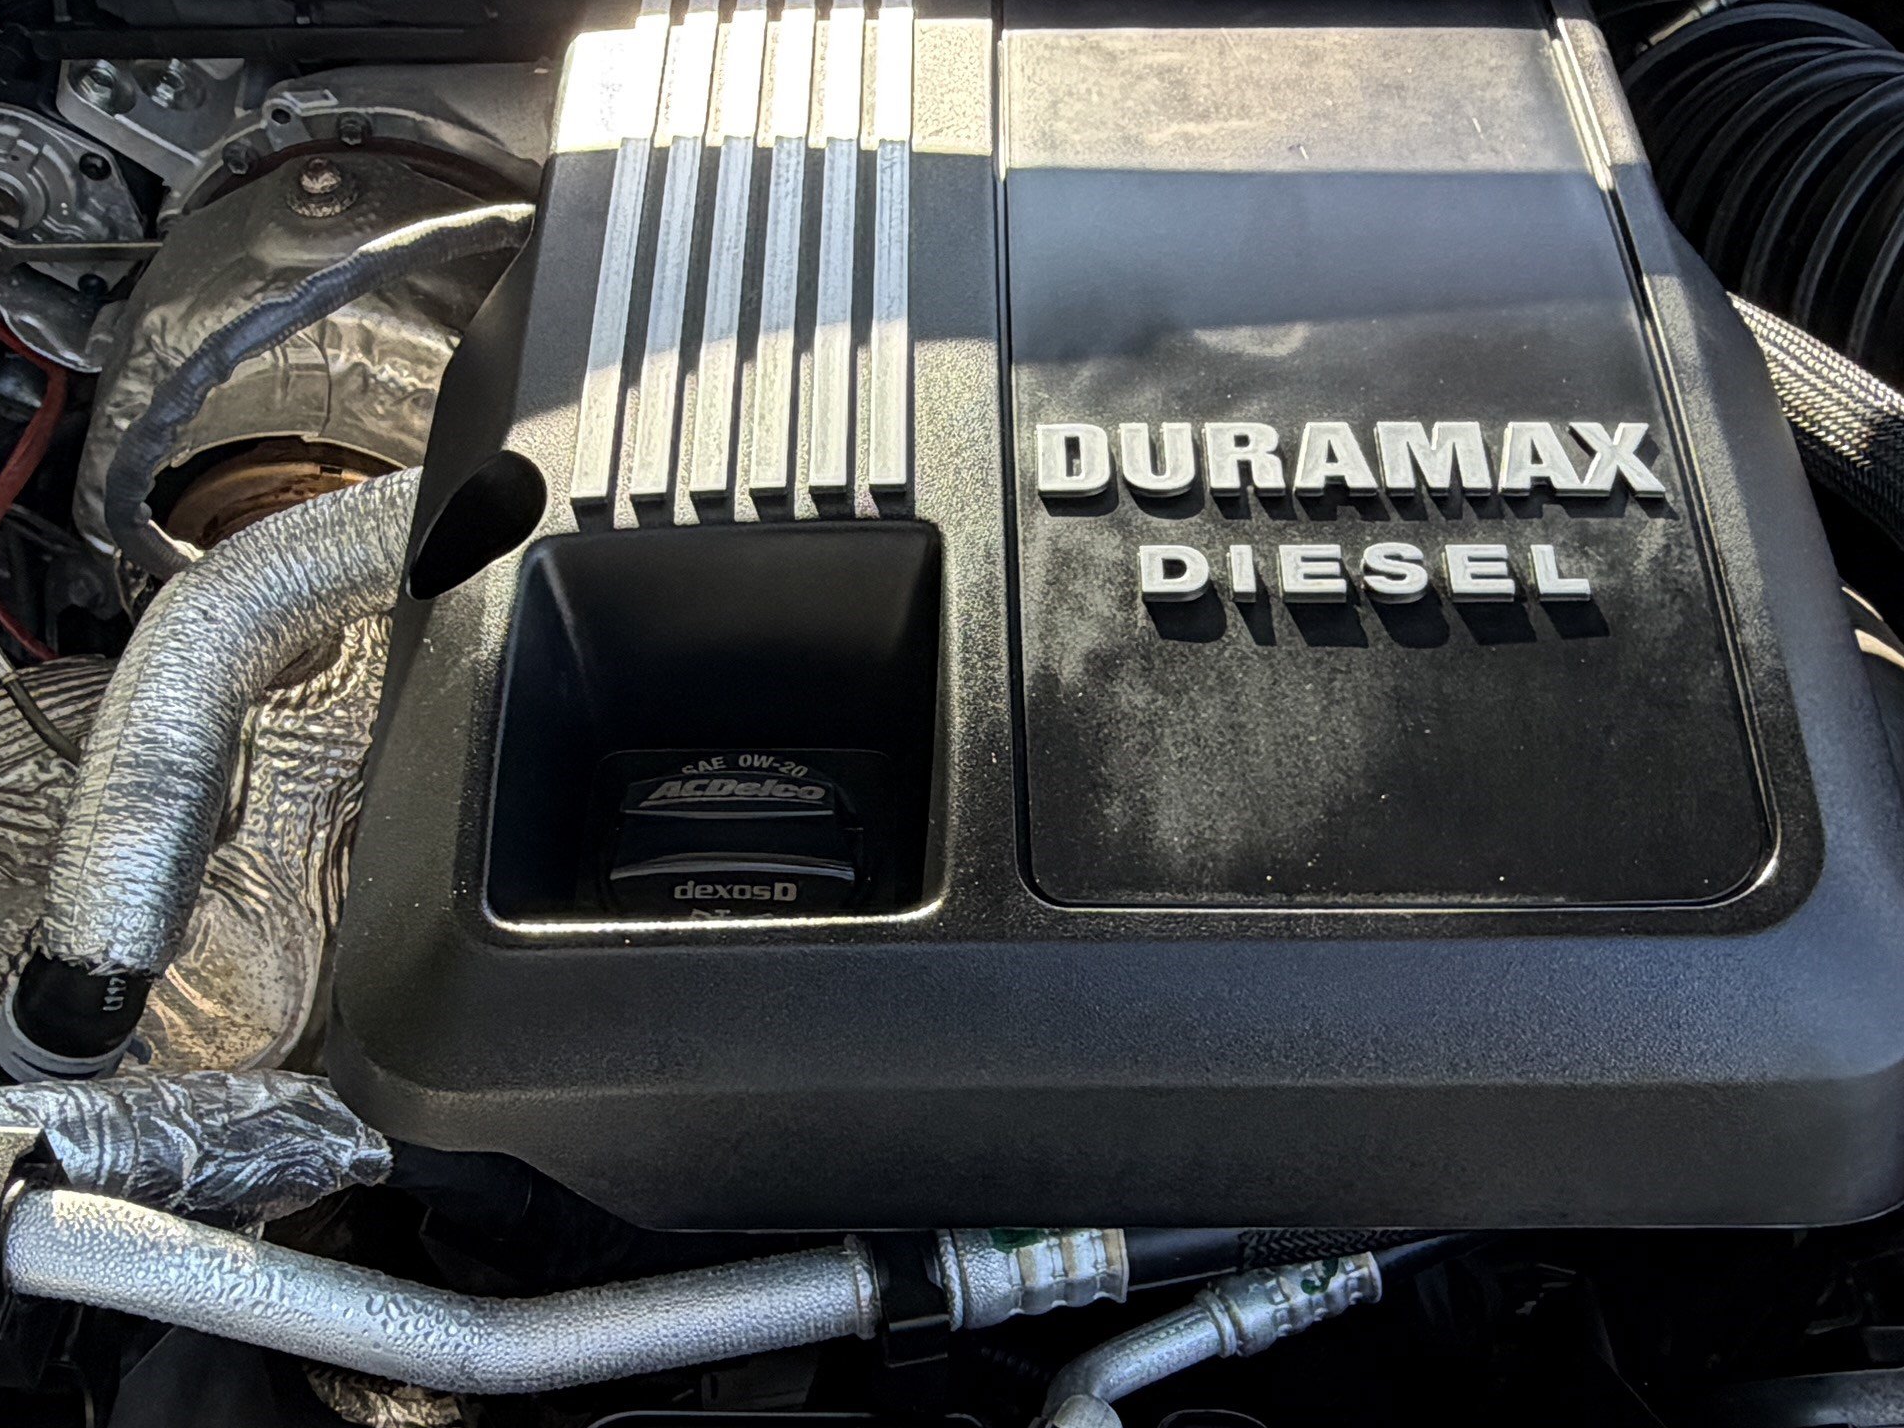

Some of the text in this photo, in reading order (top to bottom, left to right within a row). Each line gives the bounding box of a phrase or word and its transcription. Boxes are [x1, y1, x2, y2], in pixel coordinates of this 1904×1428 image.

[1035, 420, 1667, 498] DURAMAX
[1138, 542, 1592, 604] DIESEL
[682, 753, 809, 779] SAE 0W-20
[647, 778, 827, 800] ACDelco
